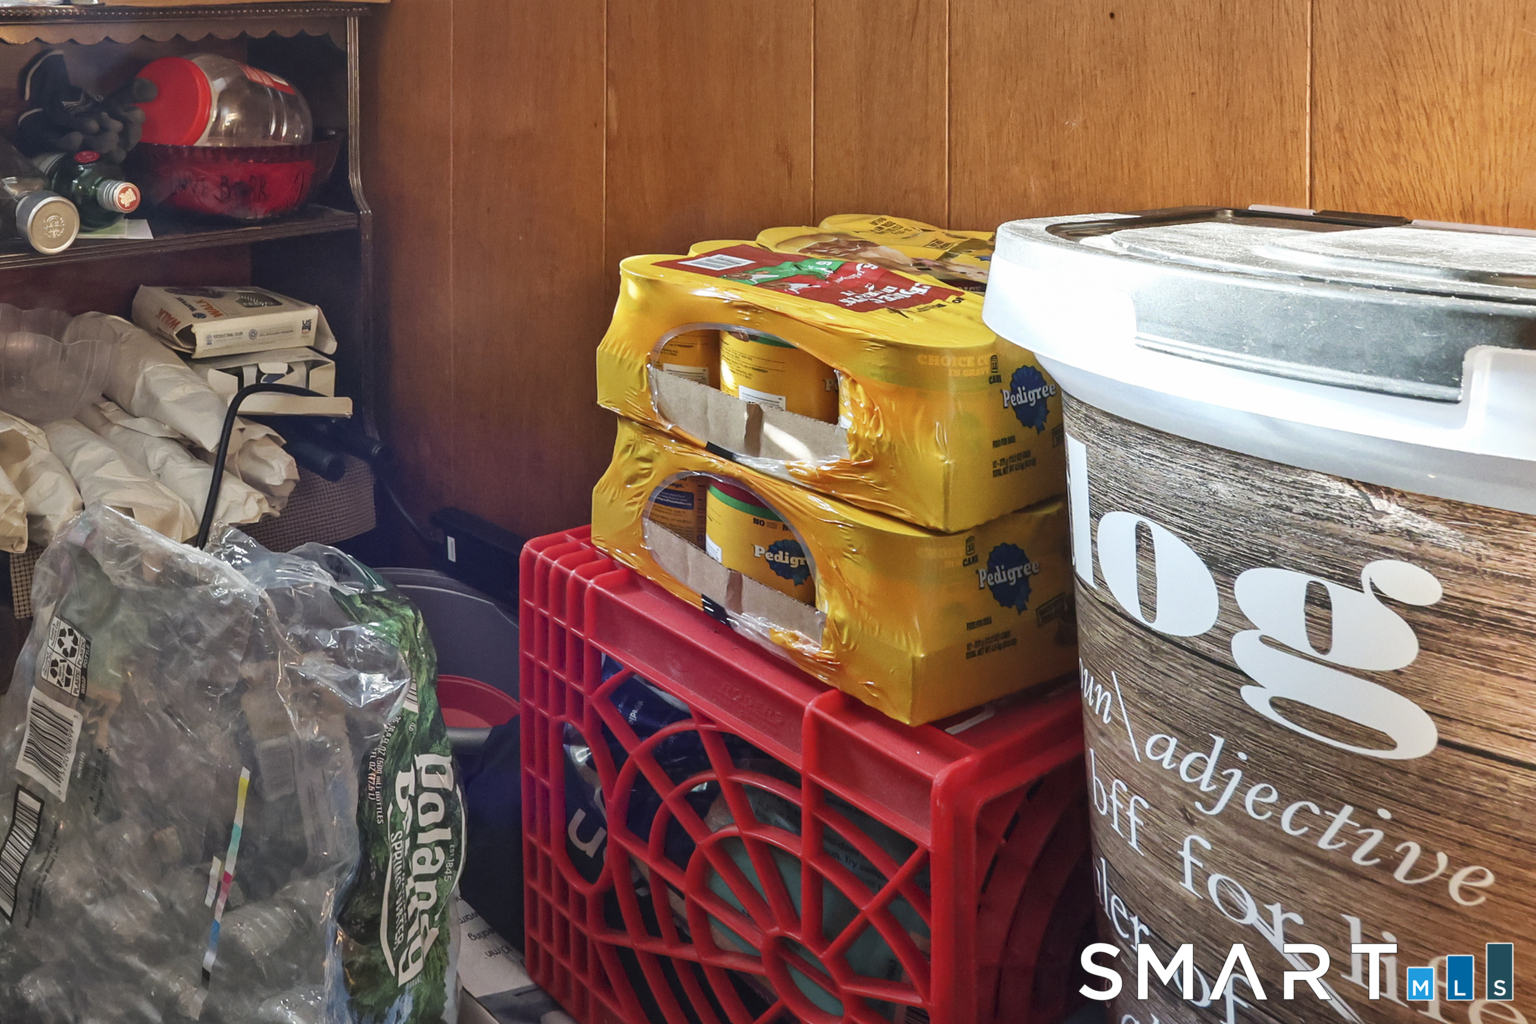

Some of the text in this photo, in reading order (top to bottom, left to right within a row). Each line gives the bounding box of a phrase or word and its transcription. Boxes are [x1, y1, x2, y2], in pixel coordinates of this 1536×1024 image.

[156, 307, 181, 330] WALK
[195, 298, 224, 319] WALK
[917, 354, 975, 367] CHOICE
[1001, 383, 1057, 409] Pedigree
[752, 517, 765, 527] NO
[962, 554, 979, 567] CANS
[977, 561, 1040, 590] Pedigree
[375, 791, 384, 825] BOTTLES
[390, 831, 406, 888] SPRING
[1088, 748, 1150, 857] bff
[1178, 834, 1305, 950] for
[444, 859, 455, 882] 1845
